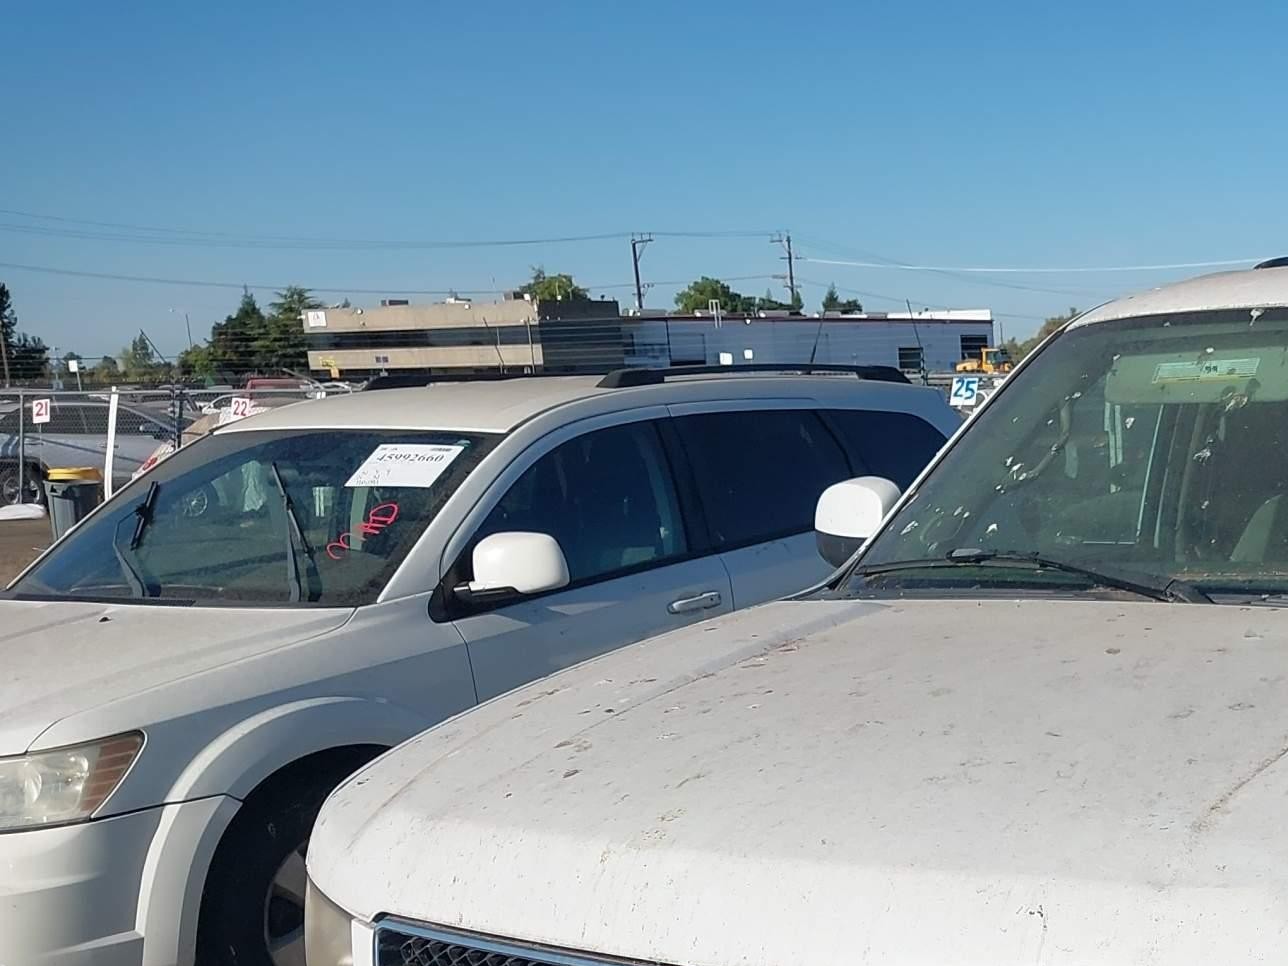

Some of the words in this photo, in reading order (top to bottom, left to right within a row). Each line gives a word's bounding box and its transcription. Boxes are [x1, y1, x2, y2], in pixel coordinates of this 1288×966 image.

[952, 377, 977, 400] 25
[34, 401, 48, 418] 21
[233, 399, 248, 416] 22
